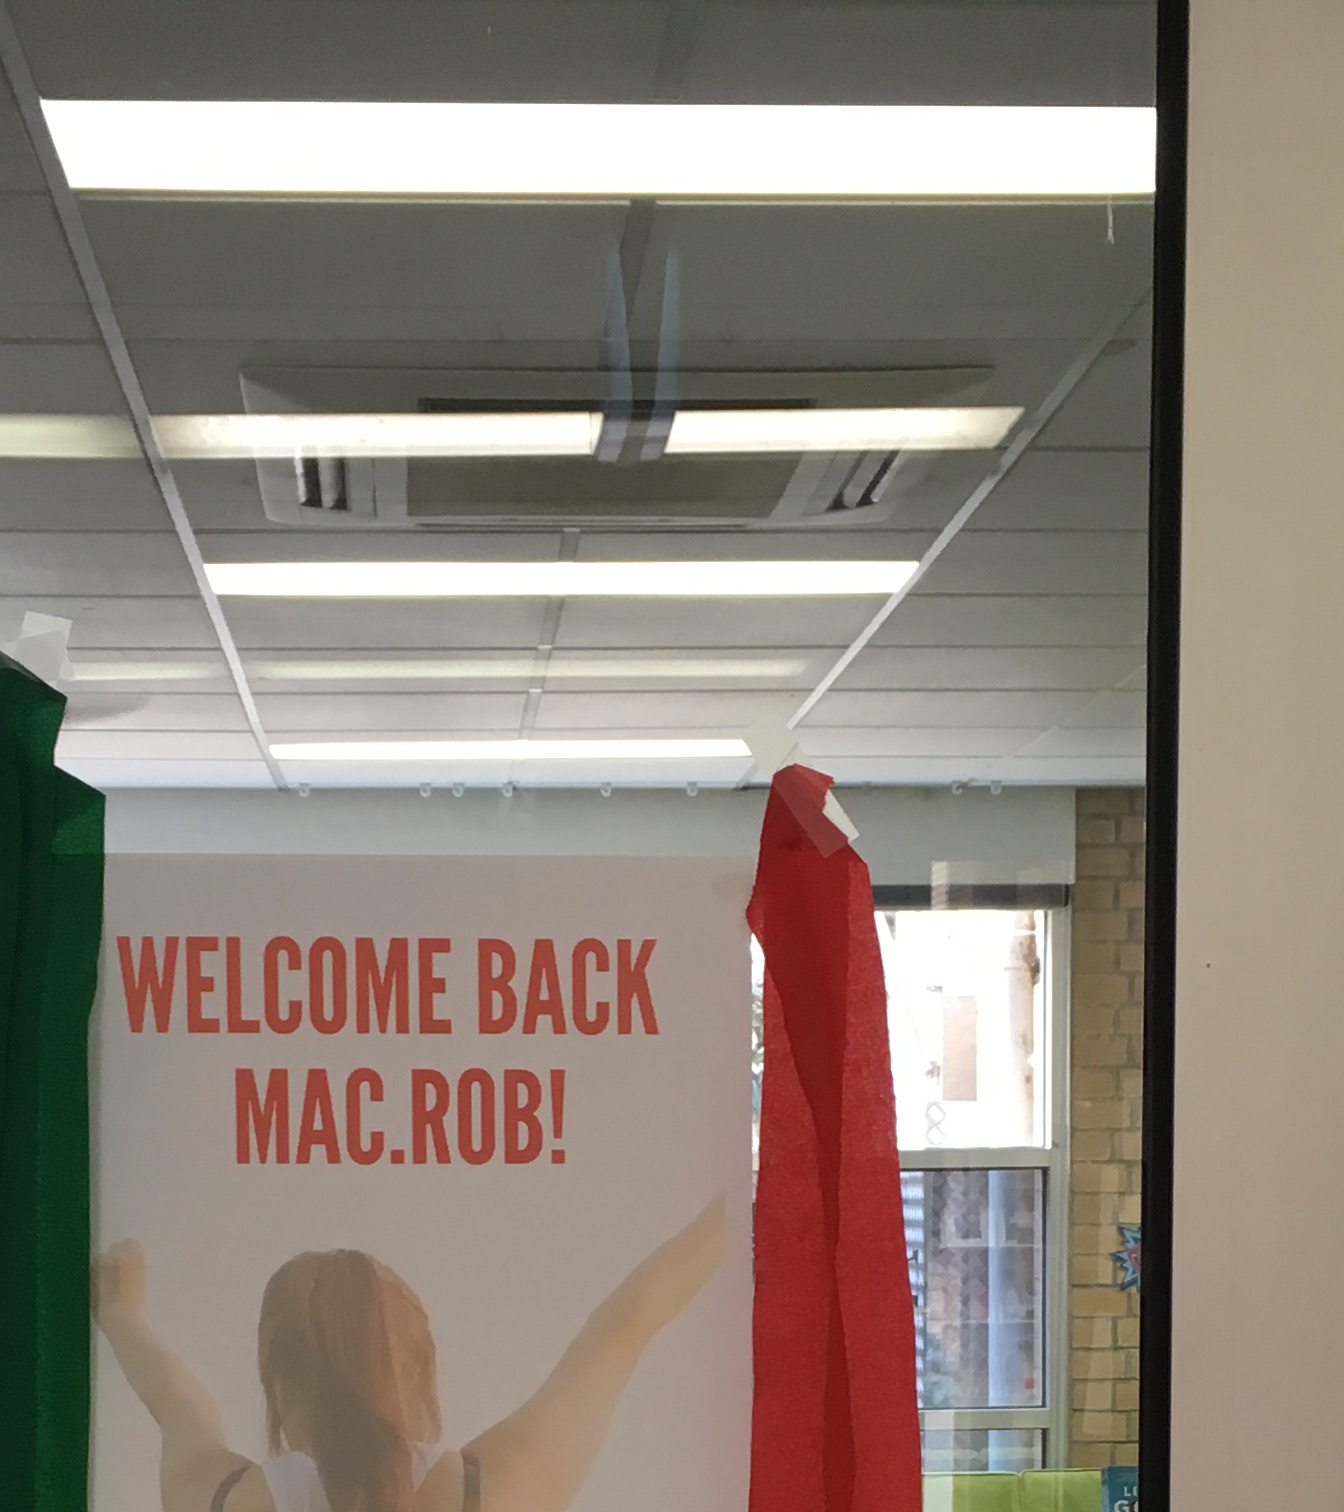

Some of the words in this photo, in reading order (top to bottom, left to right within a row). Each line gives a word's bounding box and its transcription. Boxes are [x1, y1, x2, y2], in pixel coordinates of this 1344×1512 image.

[117, 936, 452, 1035] WELCOME
[478, 938, 659, 1035] BACK
[235, 1067, 567, 1165] MAC.ROB!
